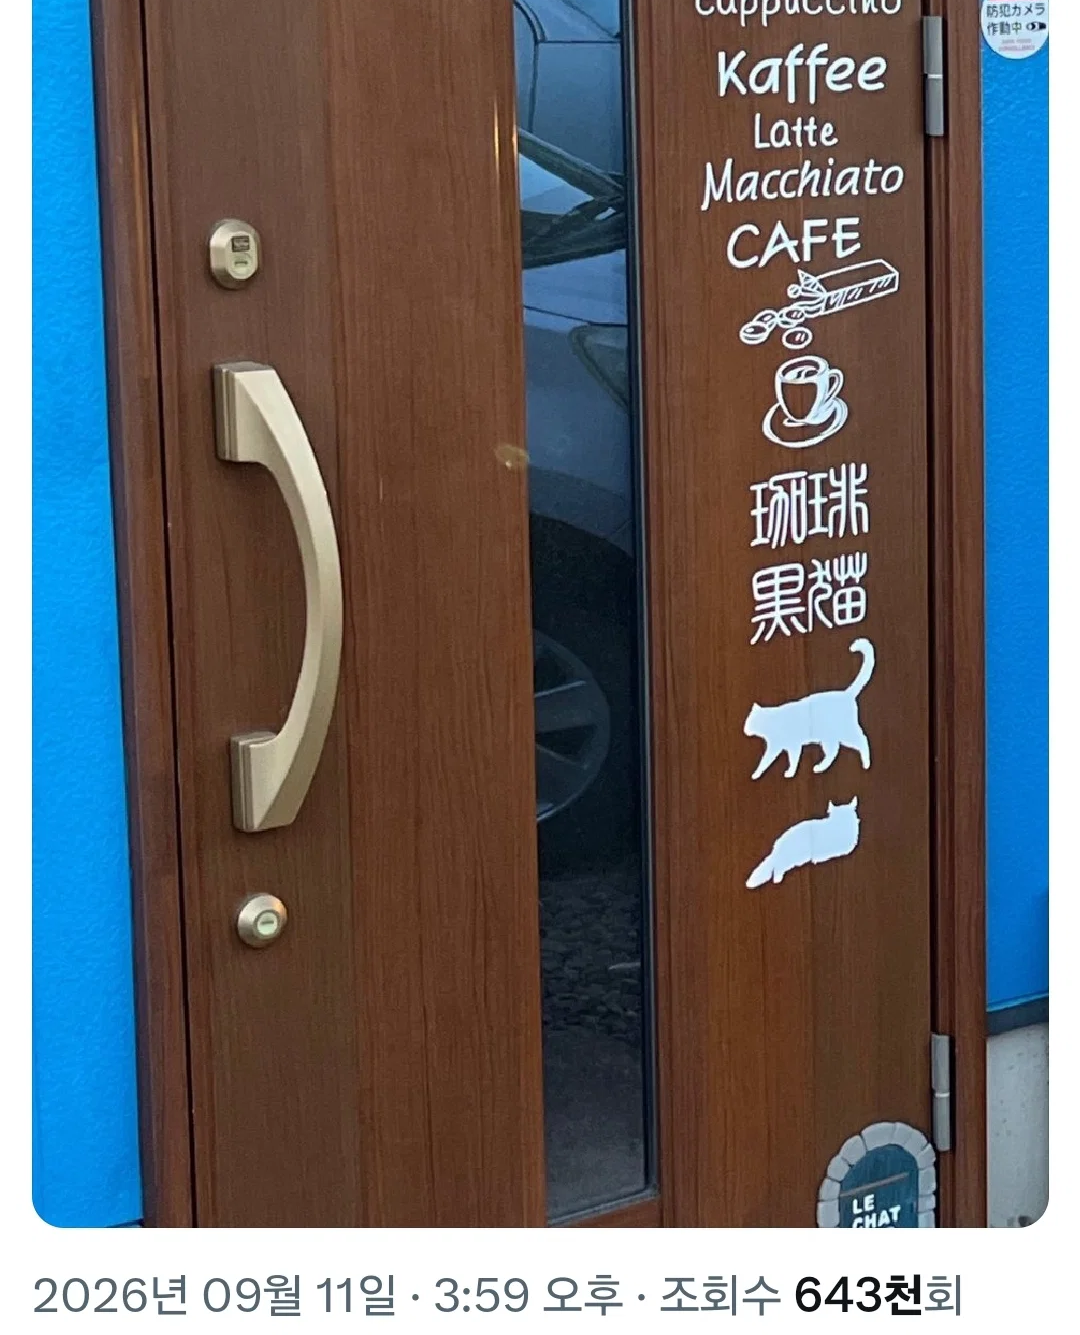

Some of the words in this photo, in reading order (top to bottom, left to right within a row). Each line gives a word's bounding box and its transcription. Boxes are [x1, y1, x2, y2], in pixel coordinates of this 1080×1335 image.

[986, 2, 1045, 18] 防犯カメラ
[987, 21, 1022, 36] 作動中
[717, 43, 887, 104] Kaffee
[754, 112, 839, 150] Latte
[700, 157, 904, 211] Macchiato
[725, 216, 862, 269] CAFE
[749, 462, 870, 550] 珈琲
[749, 551, 868, 646] 黒猫
[852, 1193, 875, 1215] LE
[852, 1204, 901, 1228] CHAT
